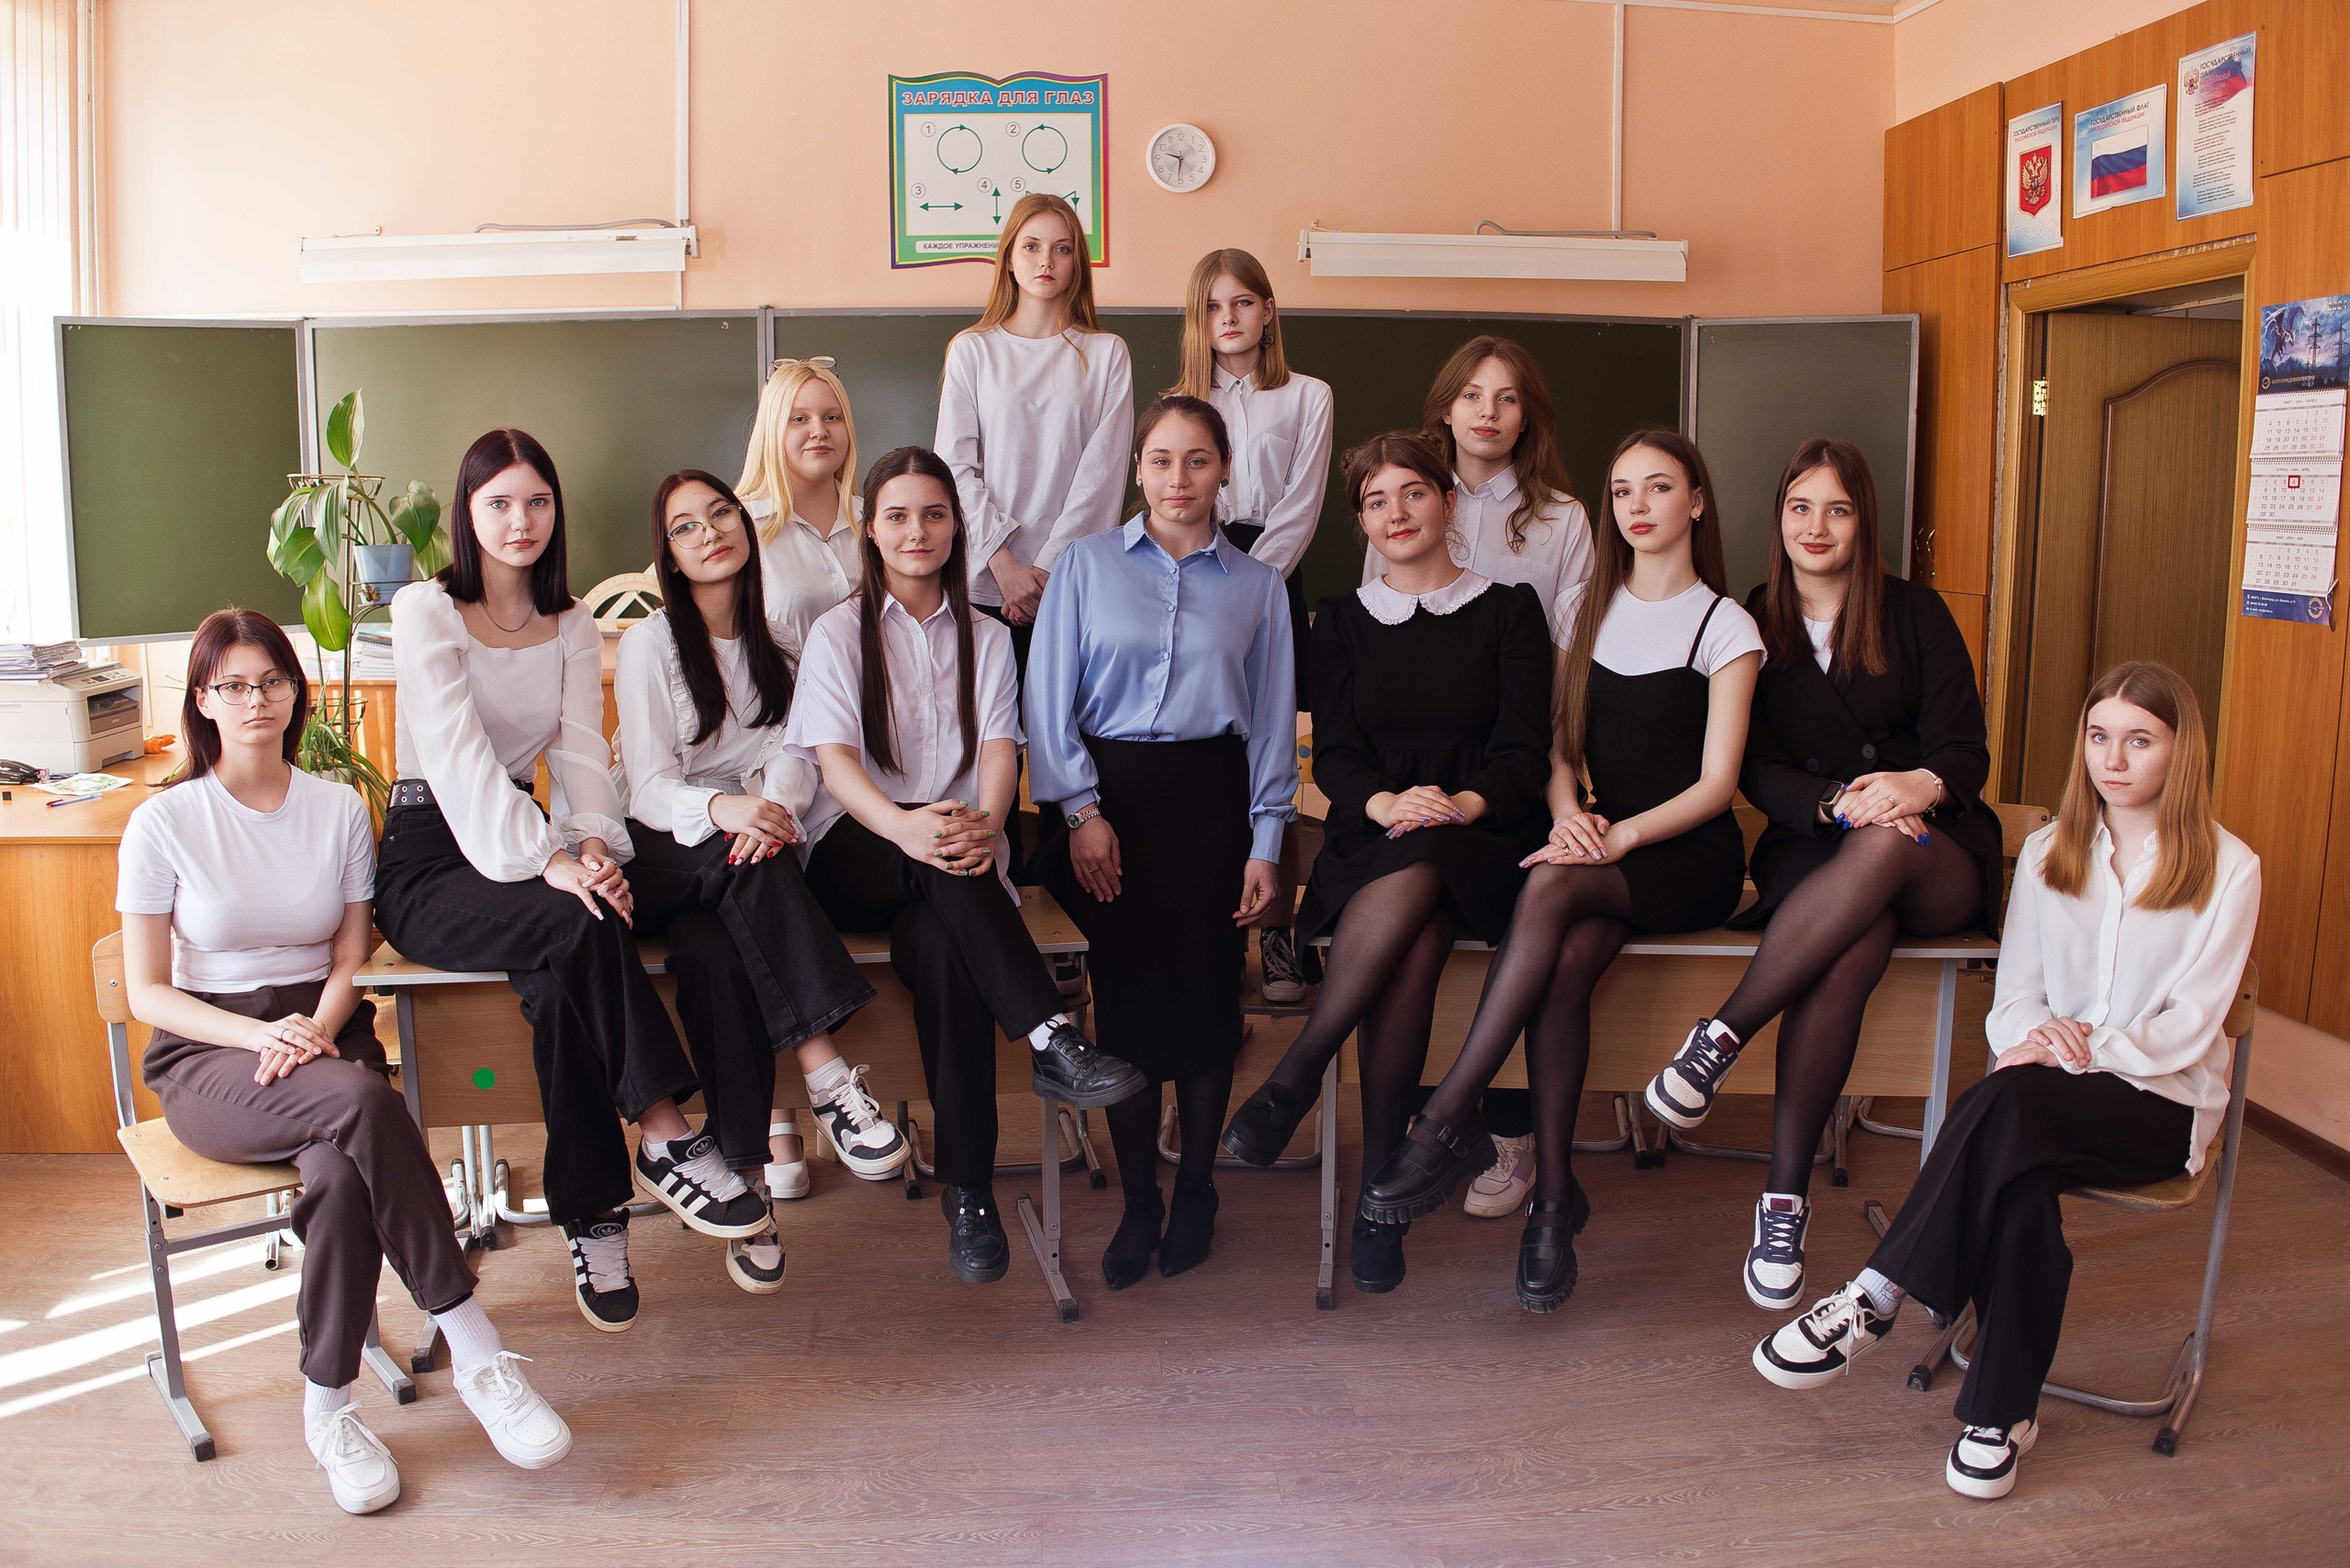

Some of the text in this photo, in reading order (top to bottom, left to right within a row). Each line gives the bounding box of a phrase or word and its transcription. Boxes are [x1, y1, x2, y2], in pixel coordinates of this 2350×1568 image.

[2200, 46, 2251, 70] ГОСУДАРСТВЕННЫЙ
[901, 91, 1094, 106] ЗАРЯДКА ДЛЯ ГЛАЗ
[2090, 102, 2149, 126] ГОСУДАРСТВЕННЫЙ ФЛАГ
[2094, 112, 2144, 131] РОССИЙСКОЙ ФЕДЕРАЦИИ
[926, 125, 930, 133] 1
[1010, 125, 1016, 133] 2
[2013, 118, 2050, 137] ГОСУДАРСТВЕННЫЙ
[1178, 133, 1185, 141] 12
[1198, 144, 1203, 152] 2
[1201, 155, 1206, 163] 3
[1167, 174, 1172, 182] 7
[1190, 174, 1195, 182] 5
[981, 181, 988, 189] 4
[1015, 180, 1021, 189] 5
[915, 186, 922, 195] 3
[2328, 300, 2347, 310] 2024
